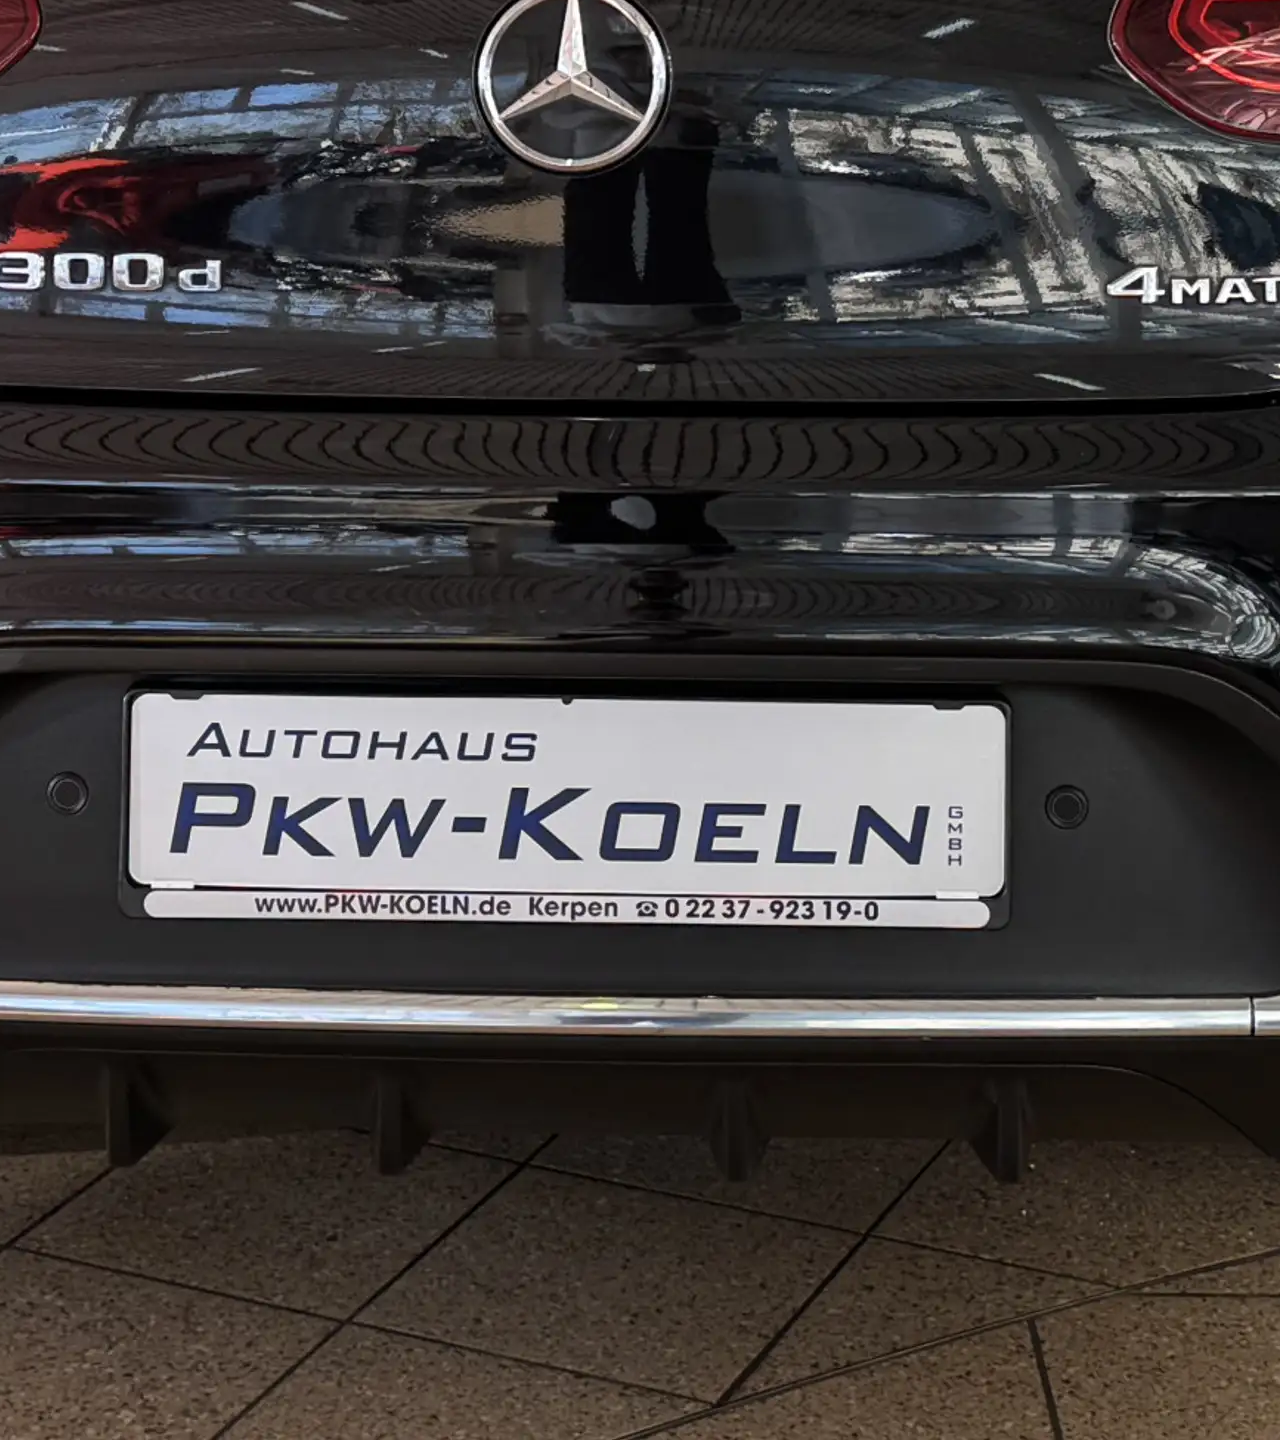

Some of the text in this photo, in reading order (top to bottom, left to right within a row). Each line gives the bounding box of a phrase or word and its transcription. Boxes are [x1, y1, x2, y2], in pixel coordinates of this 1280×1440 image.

[186, 721, 539, 763] AUTOHAUS
[169, 781, 931, 867] PKW-KOELN
[254, 893, 512, 916] www.PKW-KOELN.de
[528, 896, 619, 921] Kerpen
